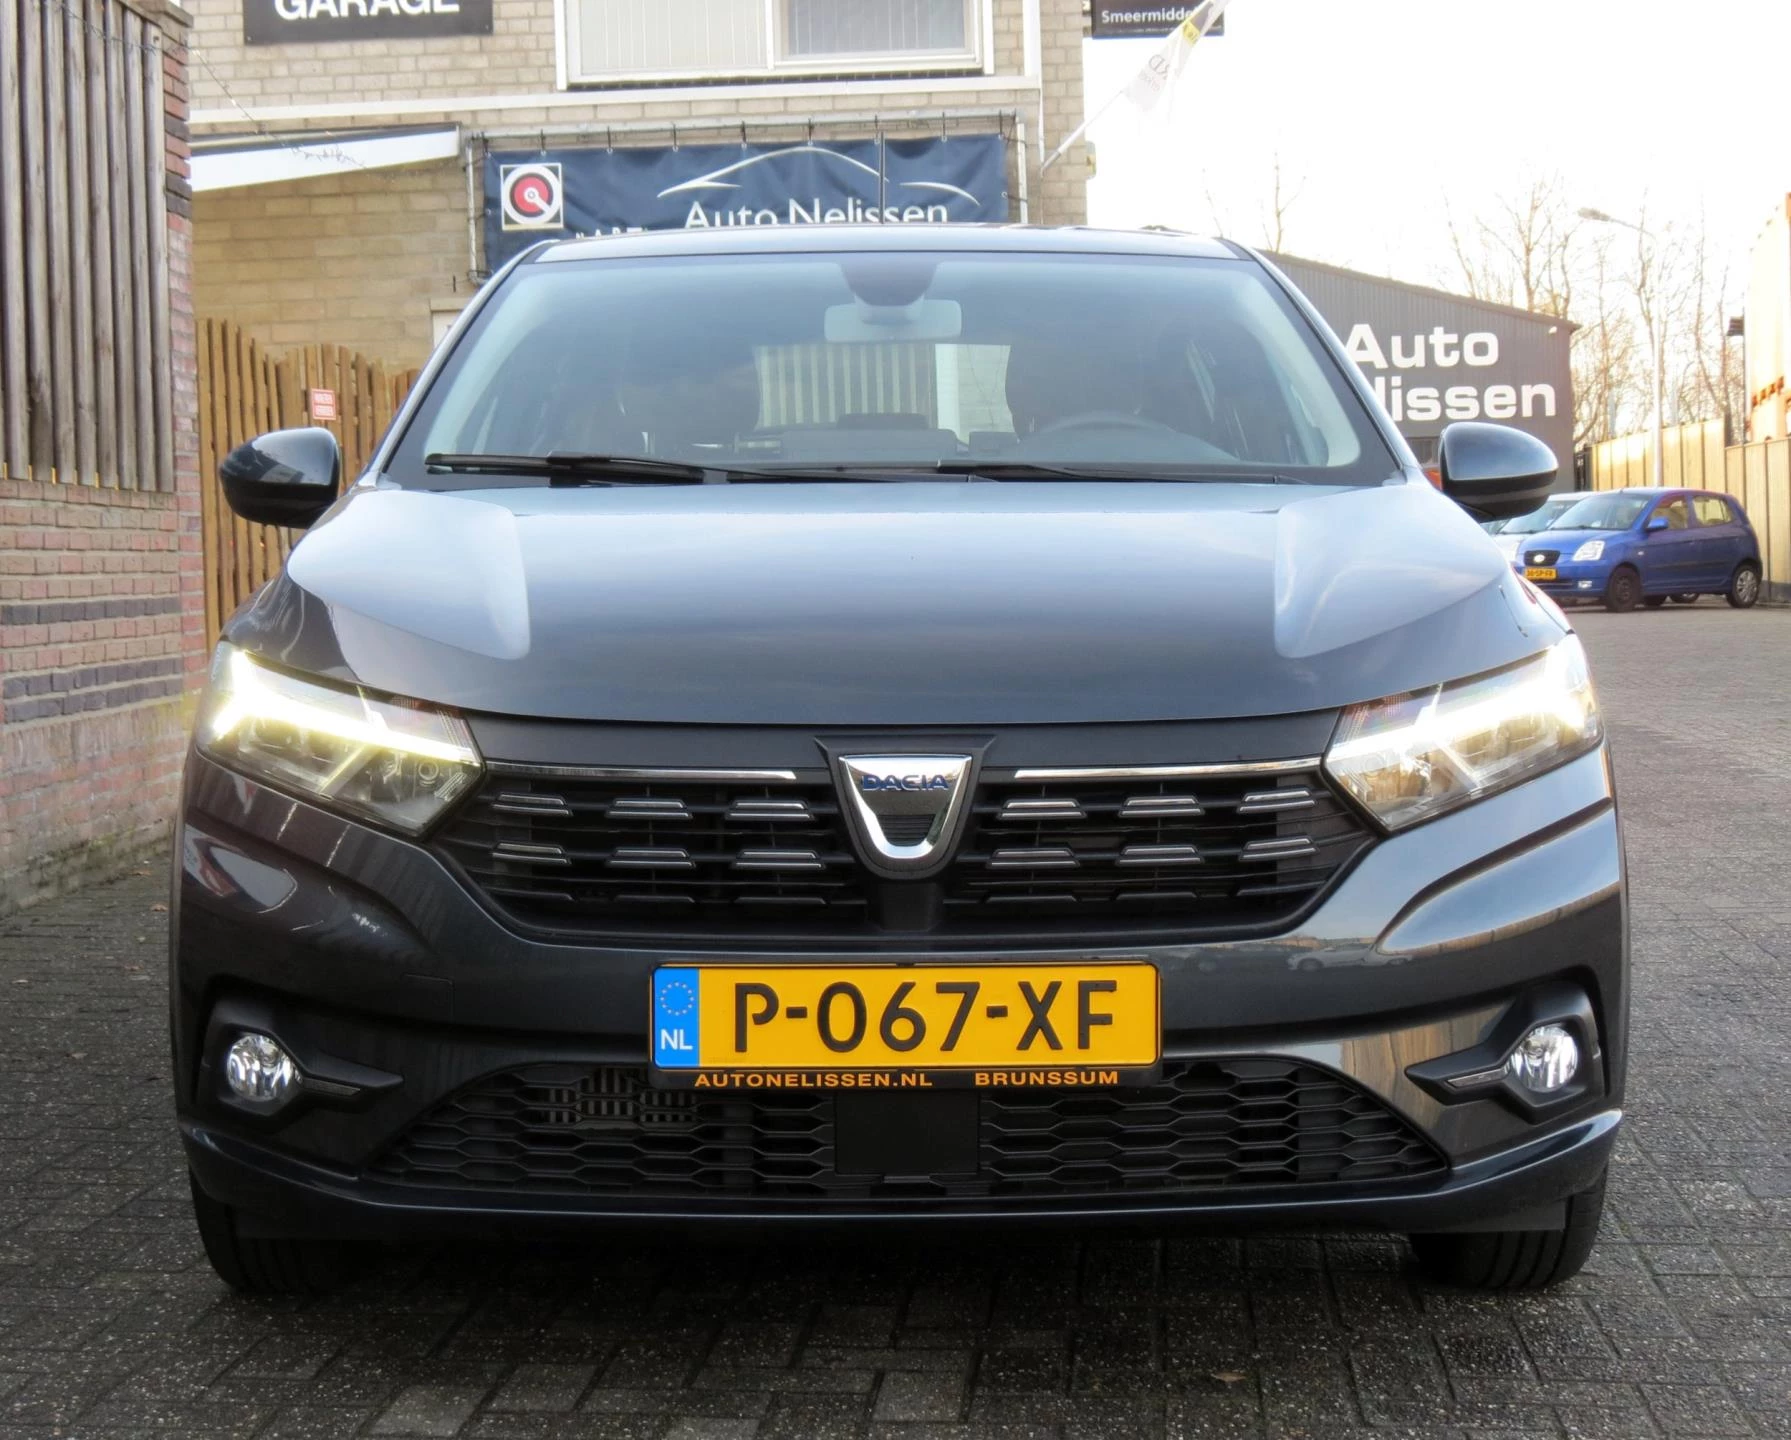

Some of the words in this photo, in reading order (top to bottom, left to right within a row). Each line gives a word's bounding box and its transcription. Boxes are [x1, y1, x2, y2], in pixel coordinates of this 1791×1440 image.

[1101, 6, 1195, 24] Smeermidde
[685, 201, 778, 229] Auto
[789, 198, 949, 225] Nelissen
[1345, 323, 1499, 369] Auto
[1374, 375, 1556, 422] lissen
[861, 774, 949, 791] DACIA
[733, 979, 1118, 1053] P-067-XF
[660, 1029, 693, 1051] NL
[694, 1071, 933, 1088] AUTONELISSEN.NL
[974, 1070, 1119, 1087] BRUNSSUM
